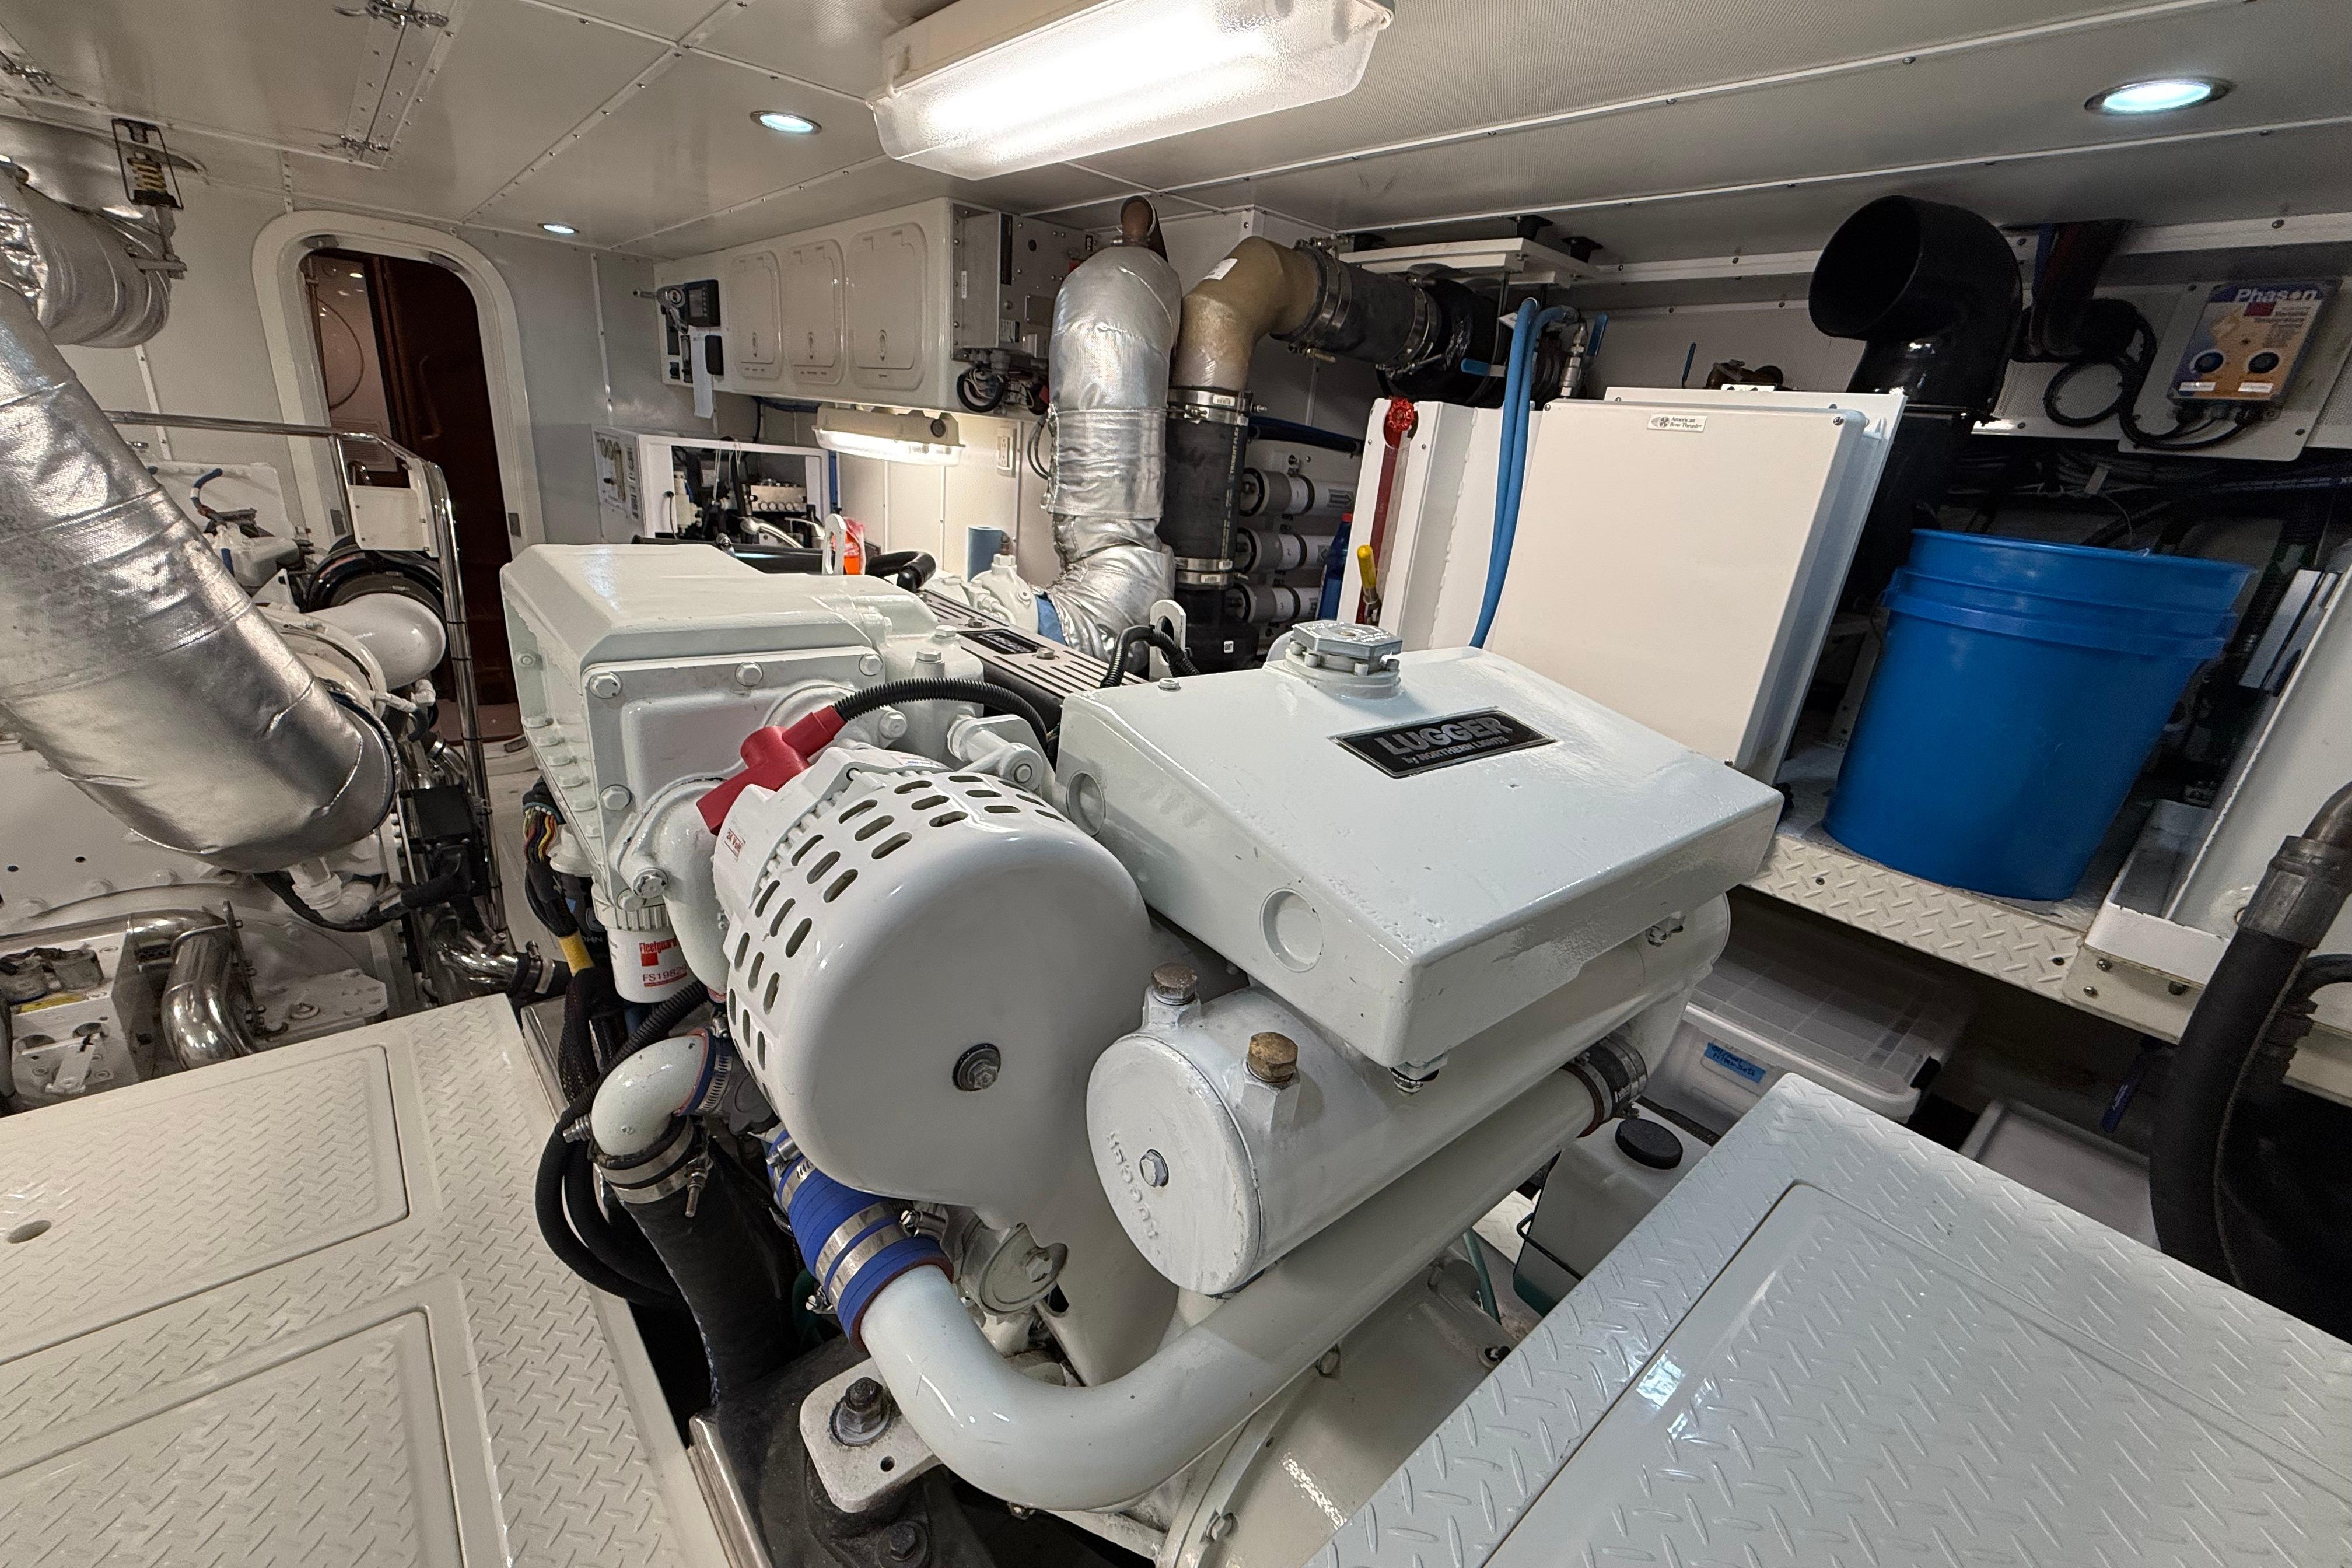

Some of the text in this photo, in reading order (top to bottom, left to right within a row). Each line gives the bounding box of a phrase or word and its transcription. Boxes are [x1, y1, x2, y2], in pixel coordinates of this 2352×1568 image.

[1374, 716, 1513, 755] LUGGER
[1419, 744, 1476, 762] NORTHERN
[639, 938, 677, 953] Fleetguard
[1108, 1131, 1159, 1239] LUGGER
